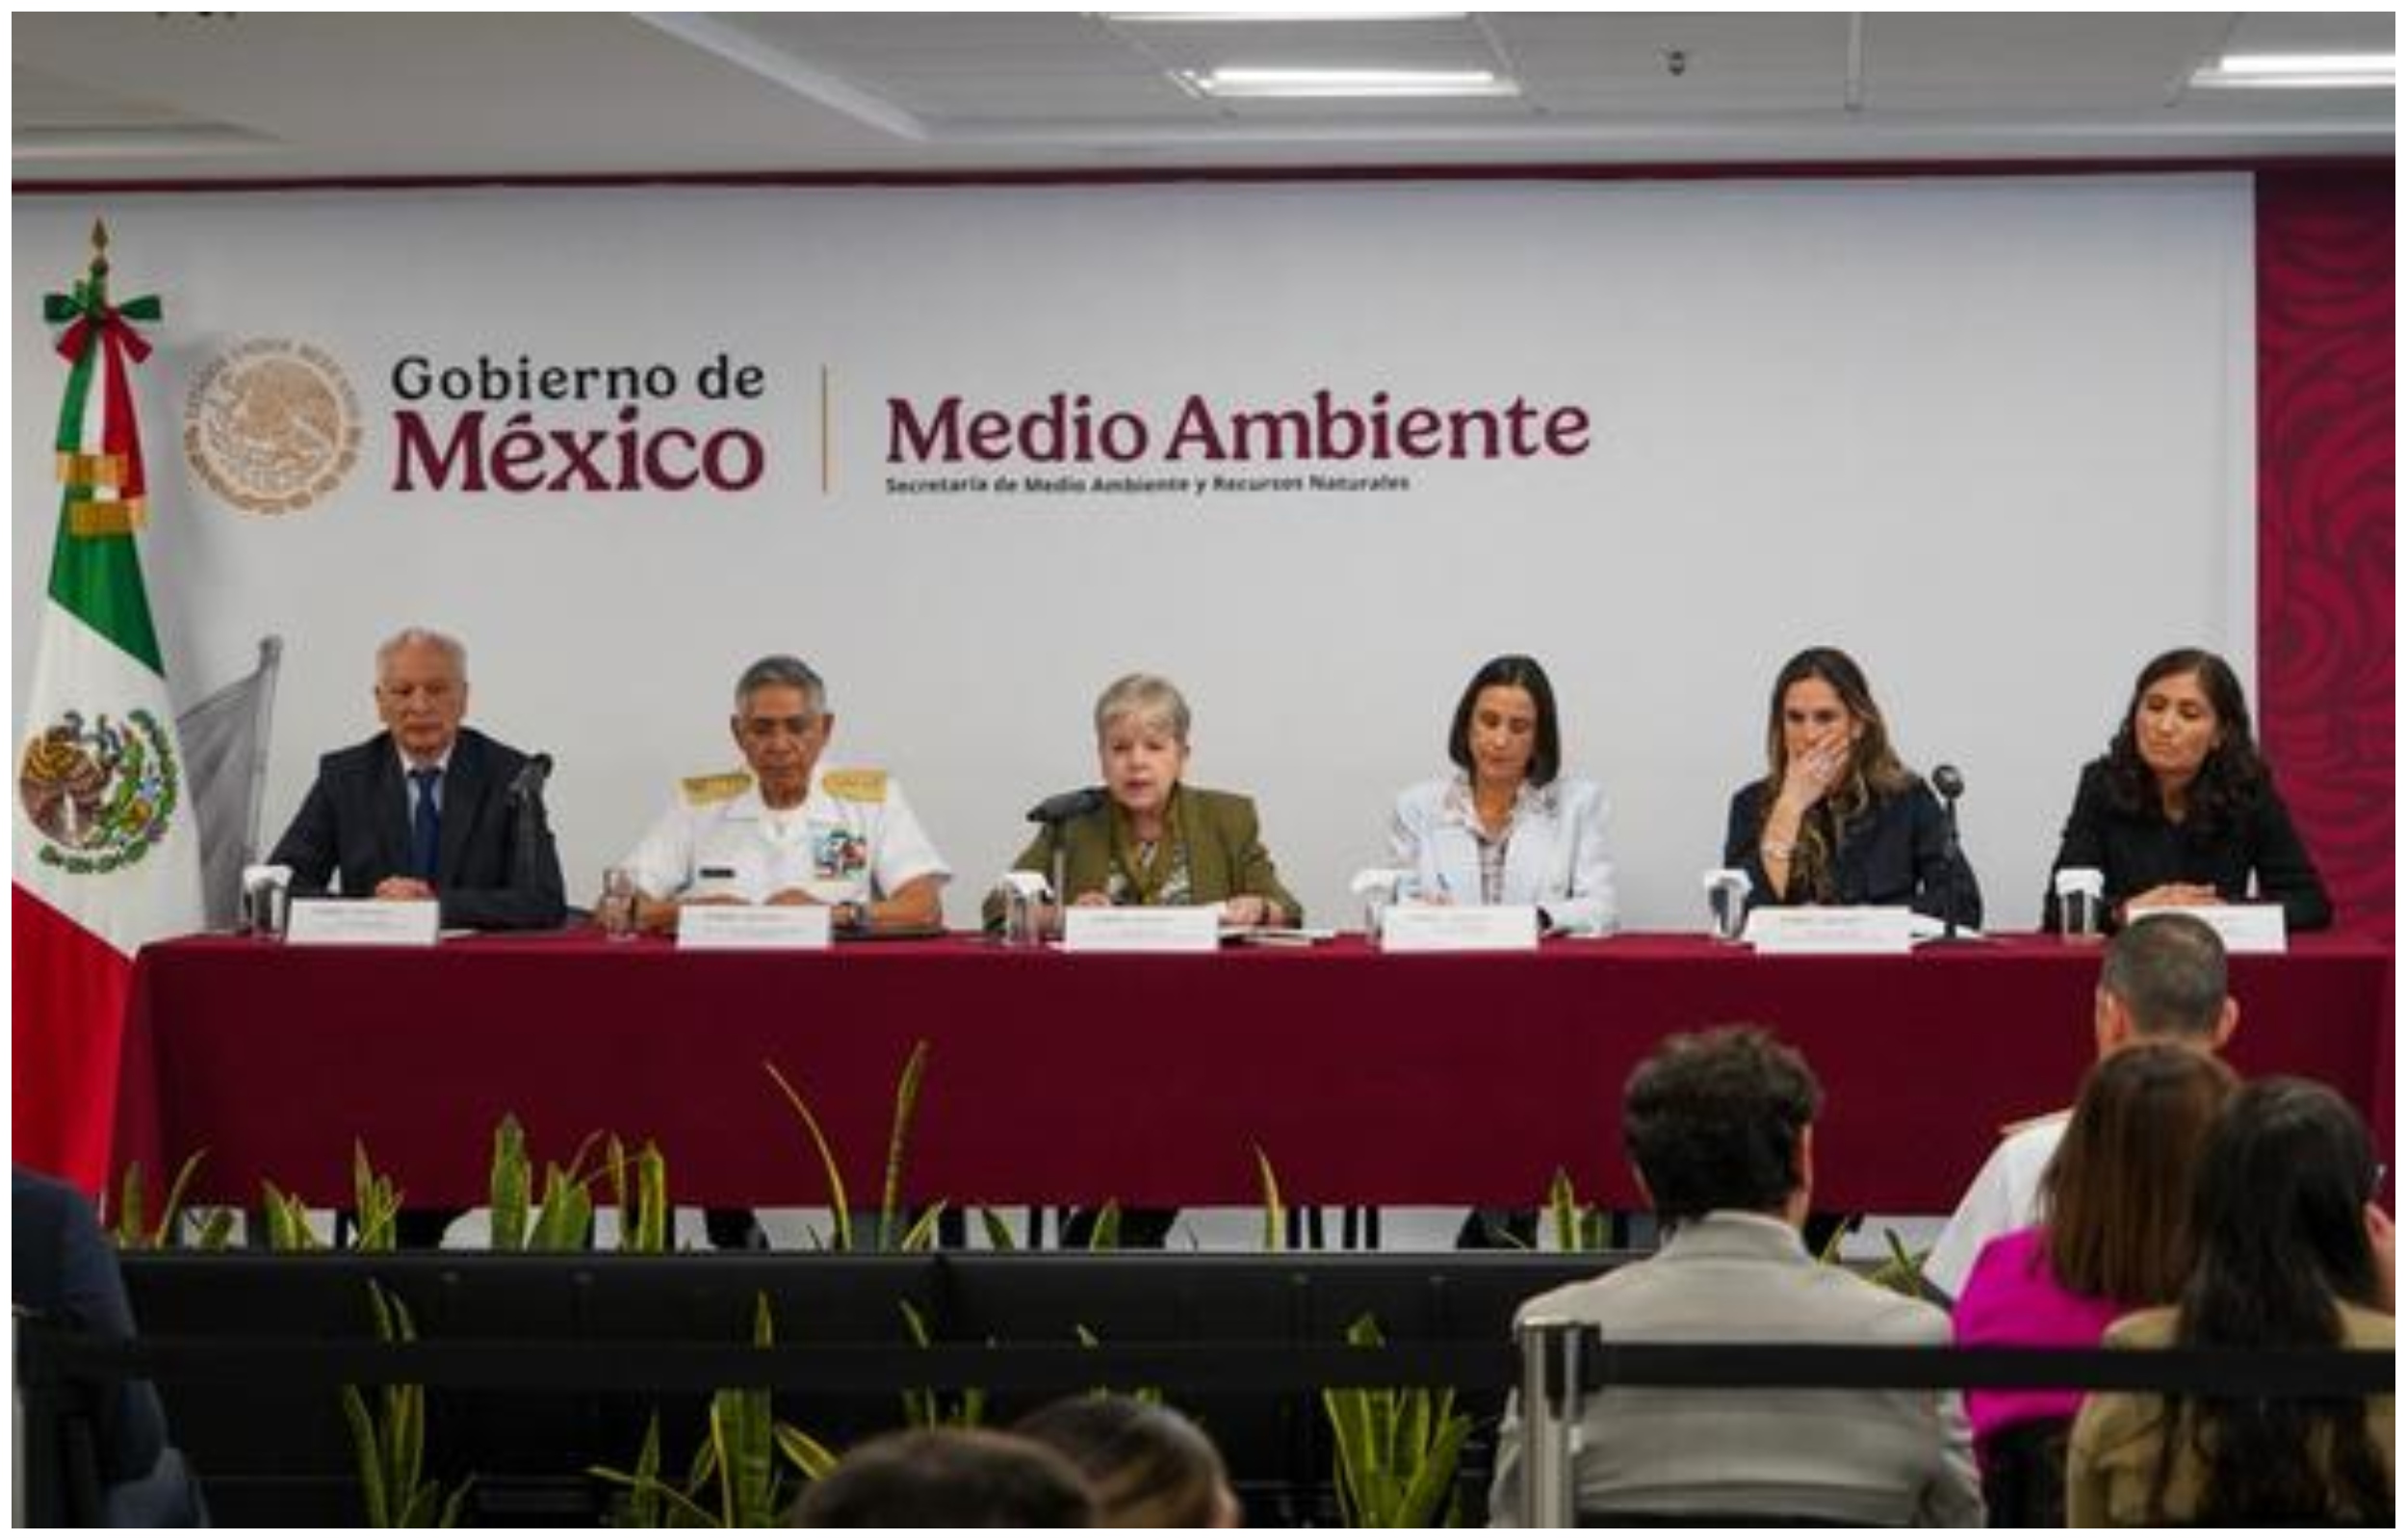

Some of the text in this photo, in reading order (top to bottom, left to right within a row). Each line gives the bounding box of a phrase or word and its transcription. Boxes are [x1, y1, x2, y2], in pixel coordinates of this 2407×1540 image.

[392, 352, 764, 401] Gobierno de
[393, 404, 764, 493] México
[886, 388, 1591, 464] Medio Ambiente
[993, 475, 1019, 493] de
[1023, 476, 1087, 493] Medio
[1090, 476, 1190, 493] Ambiente
[1193, 479, 1207, 497] y
[1212, 475, 1304, 492] Recursos
[1307, 475, 1410, 492] Naturales
